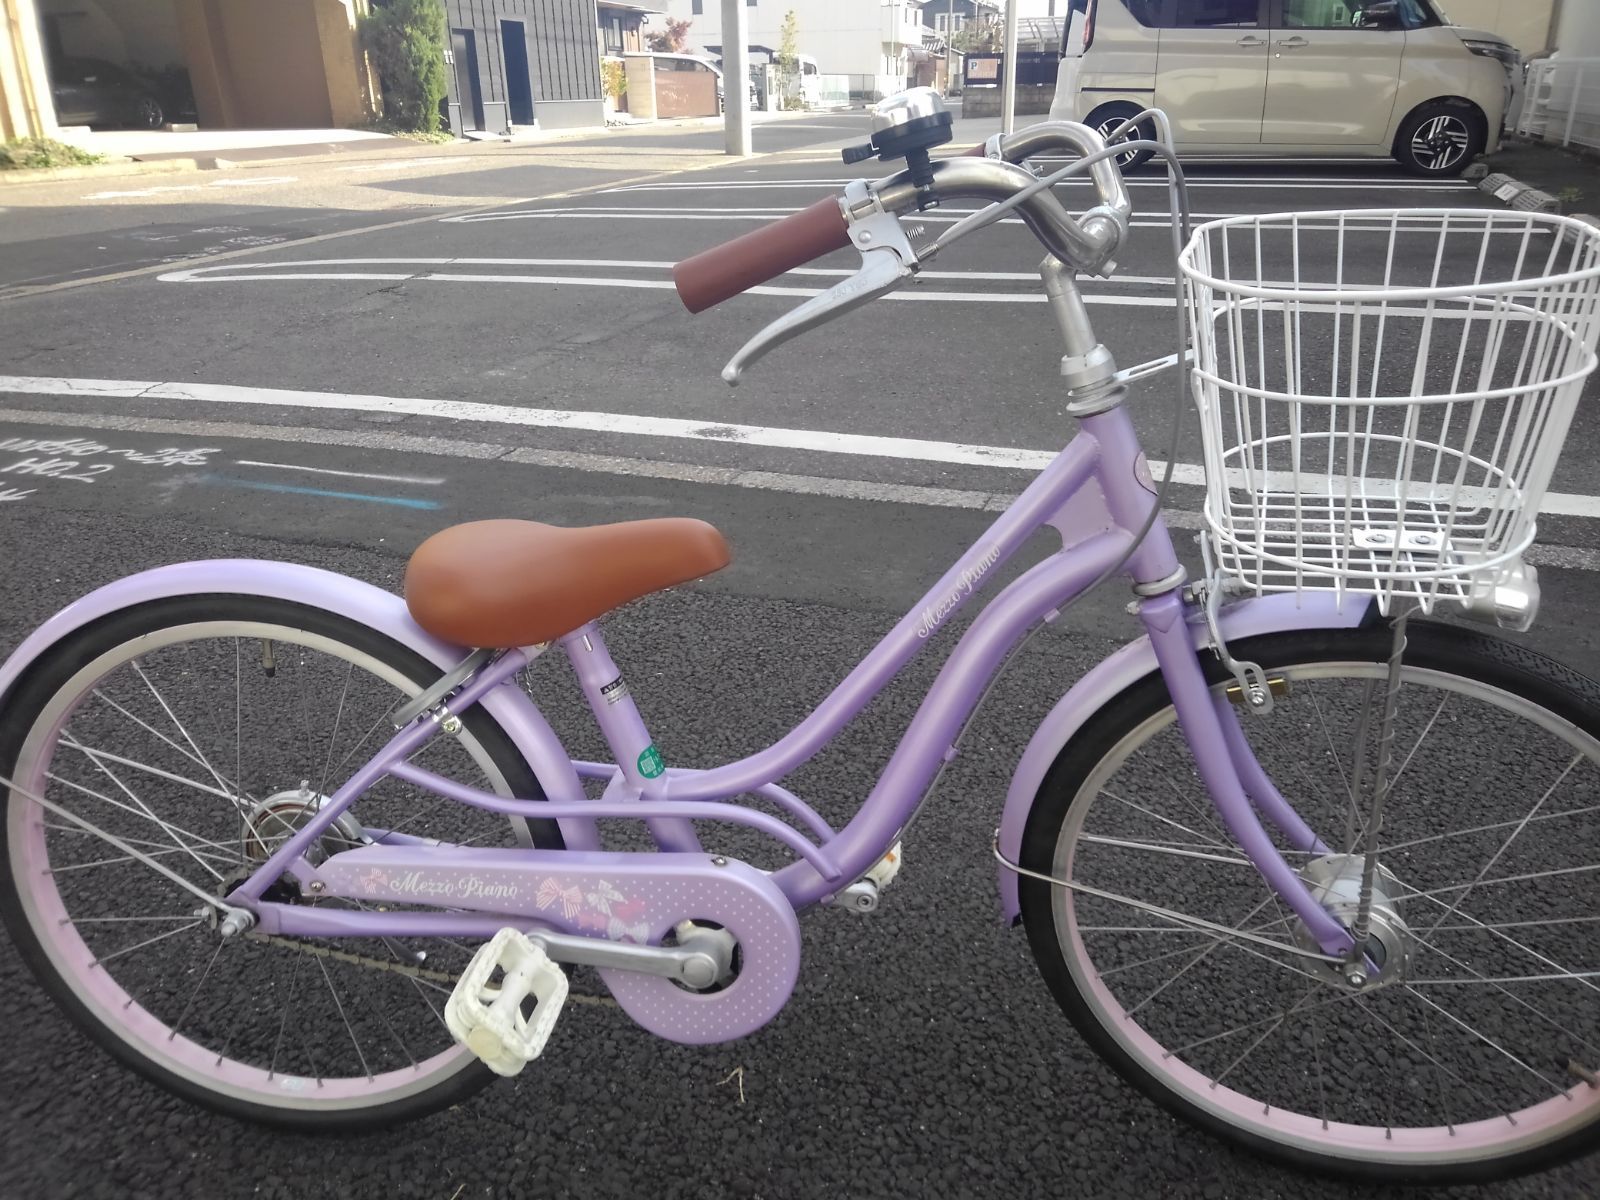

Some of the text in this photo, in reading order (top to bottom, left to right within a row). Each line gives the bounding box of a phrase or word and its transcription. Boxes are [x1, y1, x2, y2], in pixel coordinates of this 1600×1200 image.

[918, 545, 1001, 638] Mezzo Piano
[390, 871, 518, 899] Mezzo Piano
